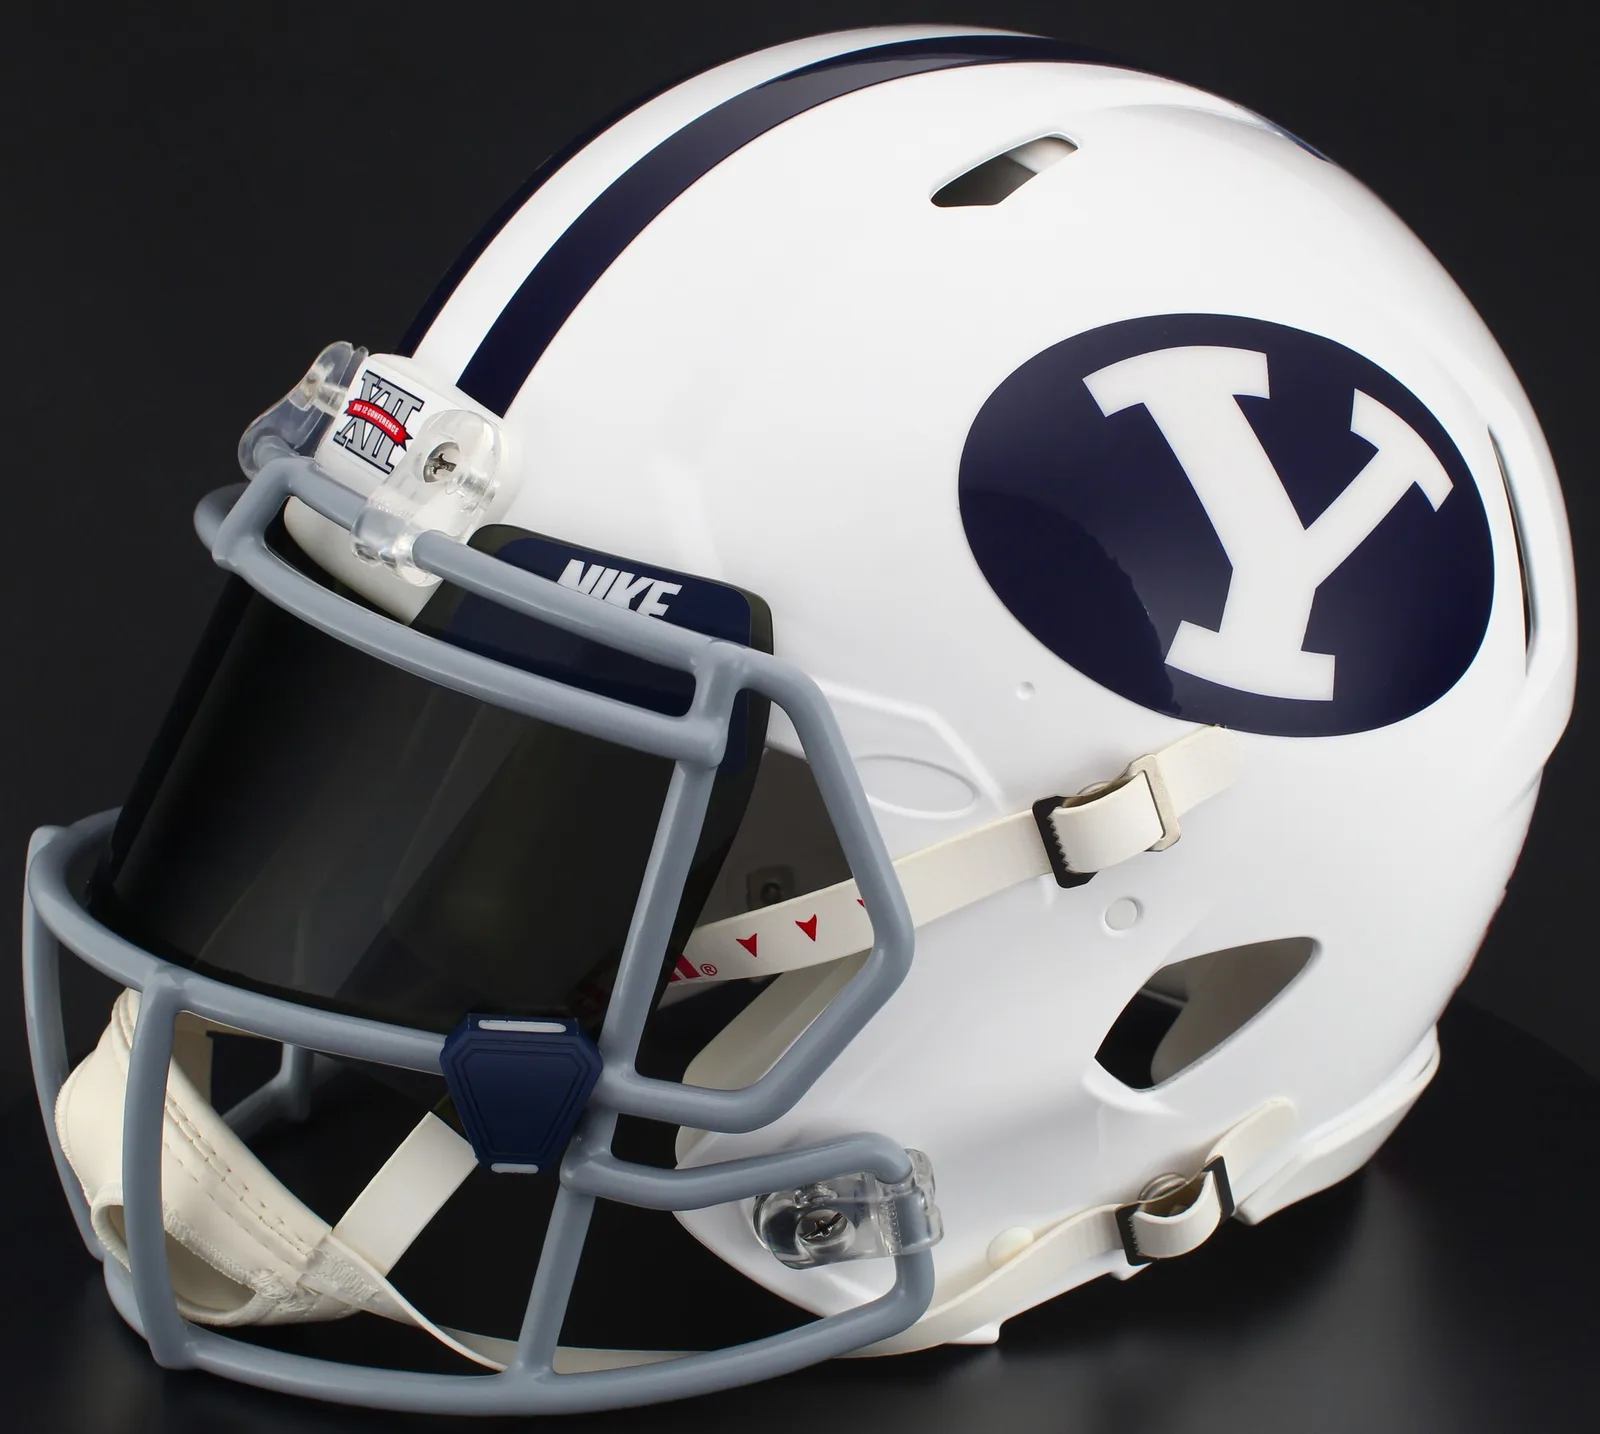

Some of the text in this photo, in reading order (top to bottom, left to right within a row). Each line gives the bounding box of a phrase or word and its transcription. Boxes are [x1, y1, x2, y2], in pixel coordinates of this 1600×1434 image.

[367, 408, 400, 436] CONFERENCE
[1082, 345, 1454, 702] Y
[557, 558, 683, 617] NIKE
